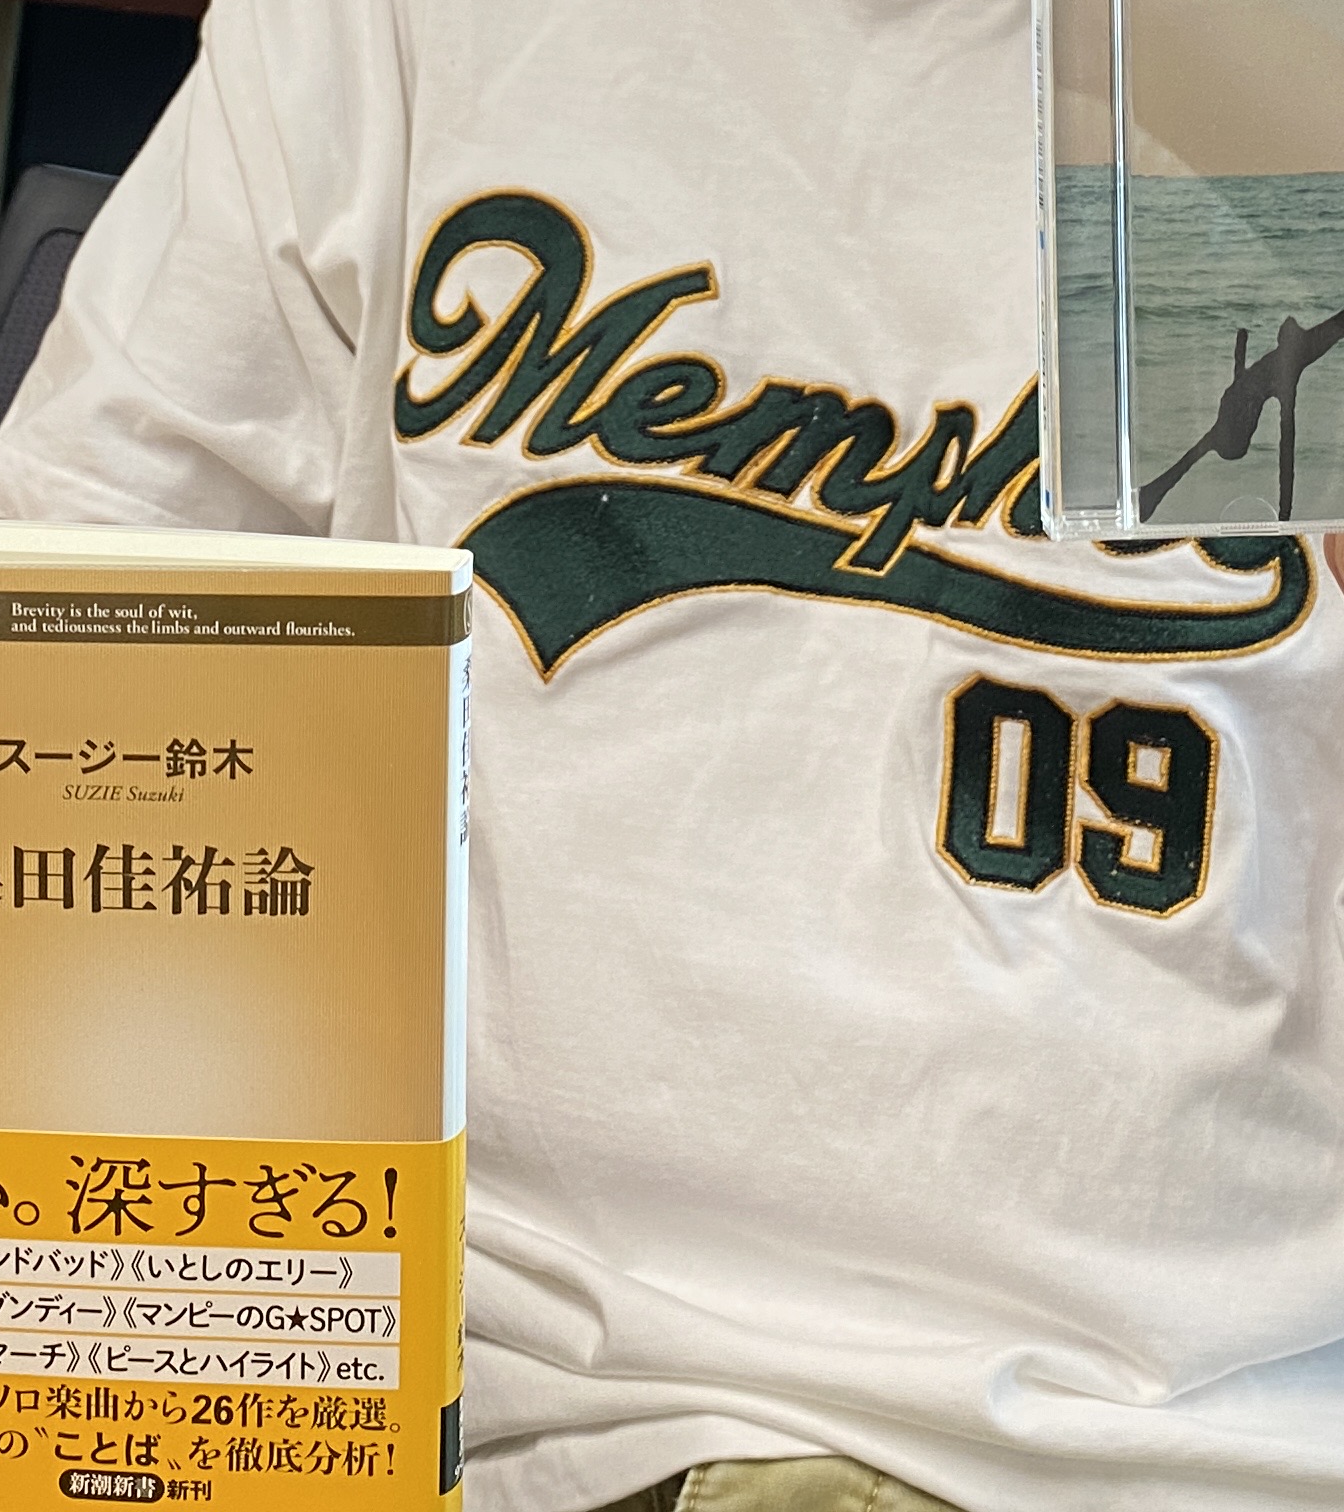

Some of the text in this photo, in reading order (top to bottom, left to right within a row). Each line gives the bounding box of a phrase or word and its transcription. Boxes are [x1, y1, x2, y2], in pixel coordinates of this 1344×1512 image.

[11, 603, 198, 621] Brevity is the soul of wit,
[11, 619, 356, 637] and tediousness the limbs and outward flourishes.
[62, 784, 185, 803] SUZIE Suzuki
[935, 671, 1219, 919] 09
[68, 1472, 213, 1502] 新潮新書 新刊
